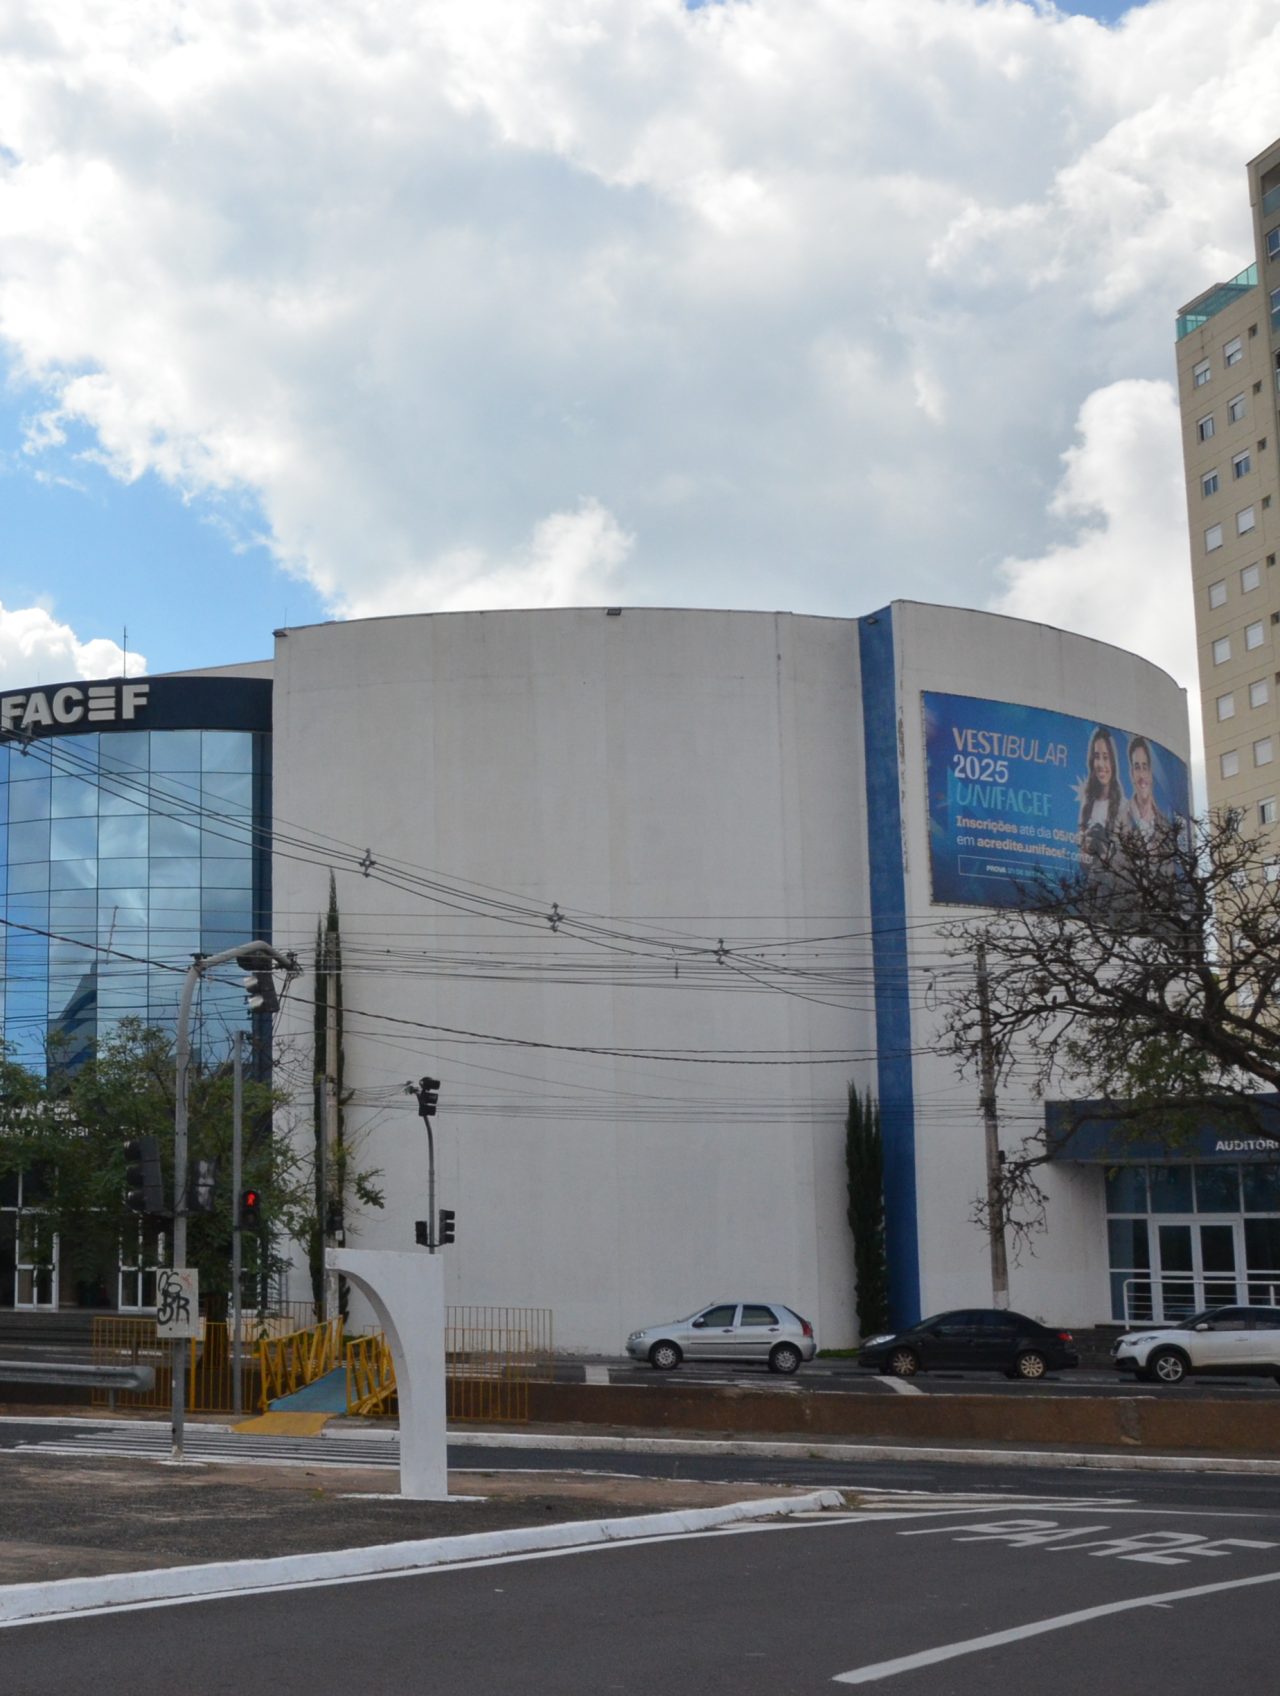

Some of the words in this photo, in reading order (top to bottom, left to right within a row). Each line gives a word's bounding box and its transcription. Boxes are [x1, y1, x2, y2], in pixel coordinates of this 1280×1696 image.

[952, 727, 1067, 767] VESTIBULAR
[953, 754, 1009, 783] 2025
[956, 784, 1052, 816] UNIFACEF
[956, 815, 1018, 834] Inscrições
[1019, 824, 1036, 836] até
[1037, 827, 1052, 839] dia
[956, 835, 975, 846] em
[896, 1518, 1280, 1565] PARE
